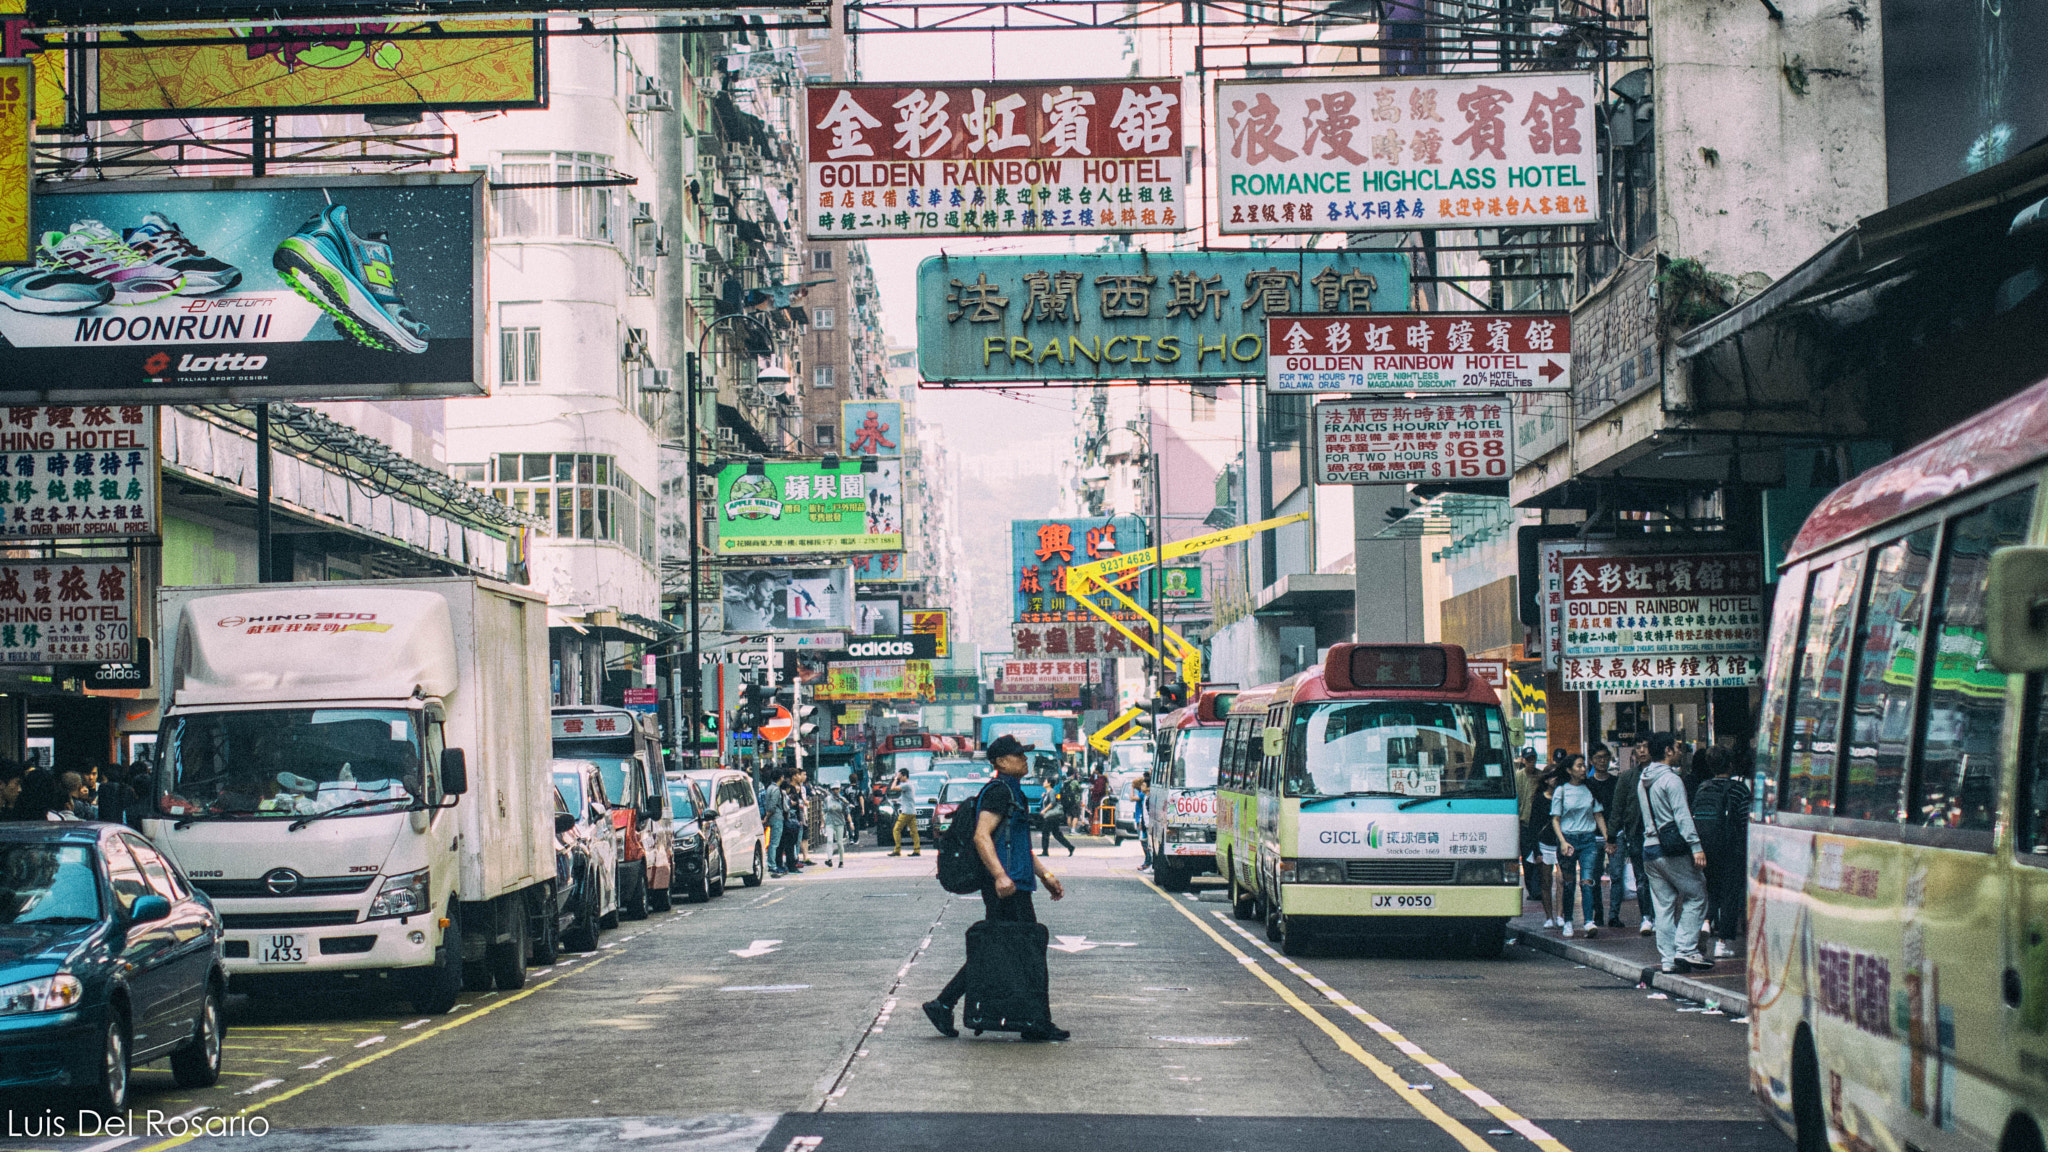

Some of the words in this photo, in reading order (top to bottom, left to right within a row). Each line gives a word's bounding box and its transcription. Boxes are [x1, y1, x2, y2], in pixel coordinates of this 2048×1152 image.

[819, 163, 924, 188] GOLDEN
[943, 160, 1062, 186] RAINBOW
[1084, 159, 1172, 183] HOTEL
[1231, 171, 1351, 196] ROMANCE
[1363, 167, 1497, 192] HIGHCLASS
[1508, 164, 1586, 189] HOTEL
[1326, 197, 1426, 221] 各式不同套房
[74, 314, 245, 342] MOONRUN
[252, 313, 272, 338] II
[983, 333, 1182, 367] FRANCIS
[177, 352, 268, 372] lotto
[1286, 356, 1363, 371] GOLDEN
[1374, 355, 1454, 370] RAINBOW
[1466, 355, 1528, 369] HOTEL
[1279, 373, 1295, 381] FOR
[1349, 374, 1364, 386] 78
[1367, 372, 1388, 380] OVER
[1394, 372, 1439, 380] NIGHTLESS
[1463, 372, 1487, 387] 20%
[1490, 371, 1518, 379] HOTEL
[1490, 379, 1533, 387] FACILITIES
[1279, 381, 1313, 389] DALAWA
[1367, 380, 1414, 388] MAGDAMAG
[1417, 380, 1457, 388] DISCOUNT
[1324, 422, 1388, 433] FRANCIS
[1393, 421, 1450, 432] HOURLY
[1457, 420, 1503, 430] HOTEL
[66, 429, 145, 449] HOTEL
[1325, 433, 1382, 443] 酒店設備
[1325, 441, 1438, 454] 時鐘二小時
[1444, 440, 1505, 458] $68
[1325, 453, 1350, 463] FOR
[1359, 452, 1386, 462] TWO
[1394, 451, 1439, 461] HOURS
[1326, 471, 1369, 482] OVER
[1378, 469, 1427, 480] NIGHT
[1431, 458, 1507, 478] $150
[784, 474, 865, 500] 蘋果園
[31, 523, 53, 534] OVER
[57, 522, 81, 534] NIGHT
[84, 522, 118, 533] SPECIAL
[124, 521, 149, 532] PRICE
[1100, 557, 1124, 573] 9237
[1127, 551, 1152, 566] 4628
[60, 605, 128, 622] HOTEL
[1569, 600, 1628, 616] GOLDEN
[1636, 599, 1700, 615] RAINBOW
[1709, 598, 1758, 613] HOTEL
[60, 635, 71, 643] TWO
[95, 623, 128, 641] $70
[95, 642, 129, 660] $150
[848, 640, 914, 656] adidas
[95, 668, 141, 680] adidas
[1721, 676, 1746, 686] HOTEL
[1177, 796, 1208, 814] 6606
[1319, 830, 1361, 845] GICL
[1449, 831, 1488, 843] 上市公司
[1386, 847, 1403, 855] Stock
[1405, 847, 1420, 855] Code
[1449, 845, 1488, 855] 樓按專家
[189, 869, 224, 878] HINO
[1375, 896, 1392, 907] JX
[1397, 895, 1432, 907] 9050
[272, 935, 294, 949] UD
[264, 949, 303, 962] 1433
